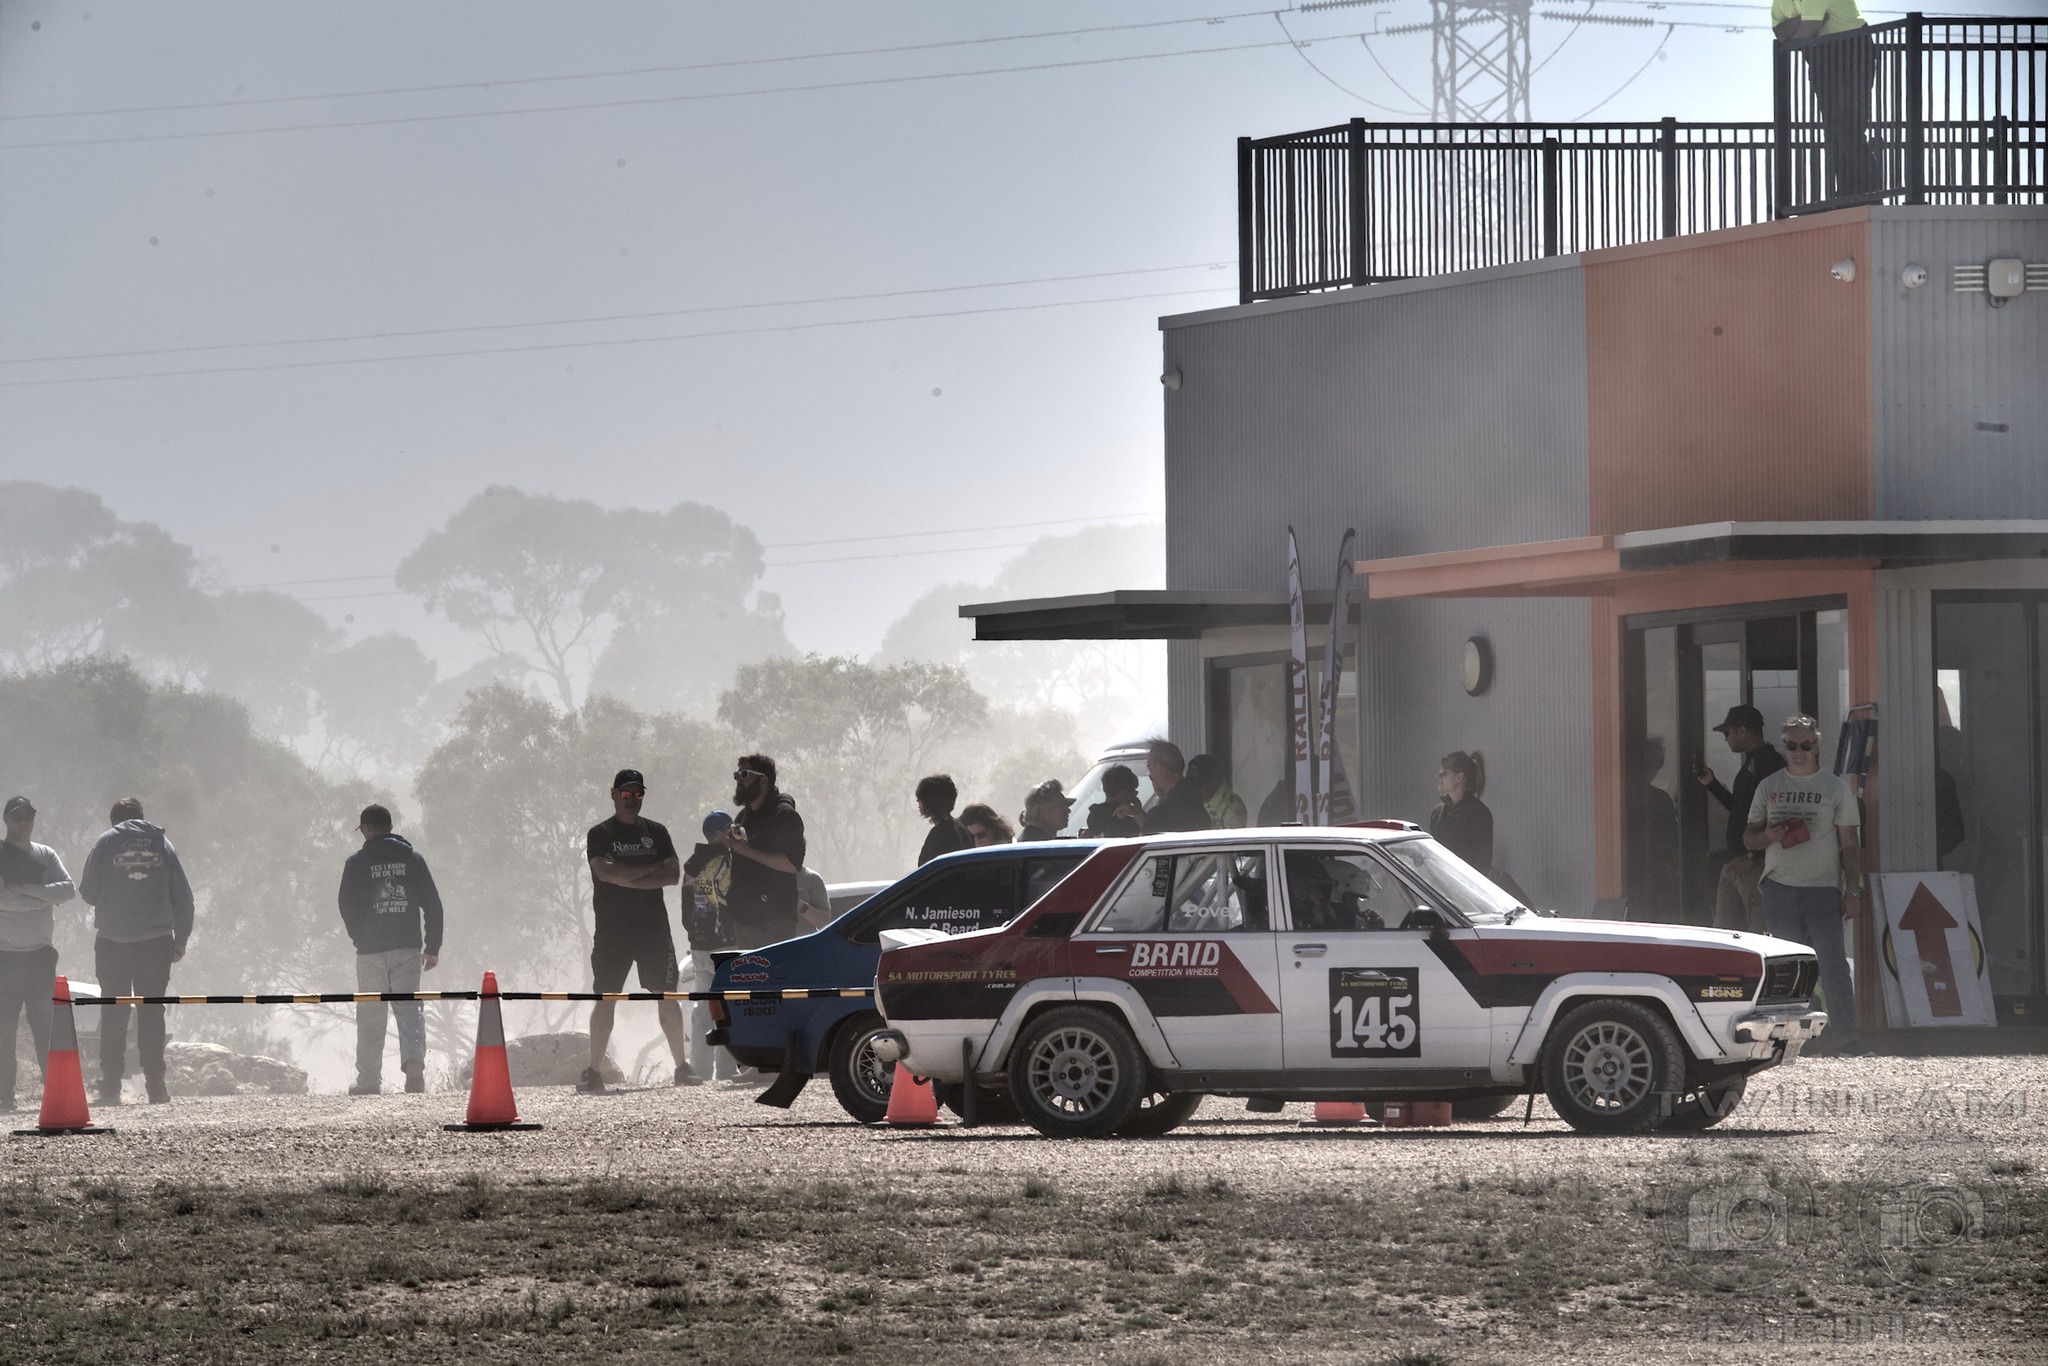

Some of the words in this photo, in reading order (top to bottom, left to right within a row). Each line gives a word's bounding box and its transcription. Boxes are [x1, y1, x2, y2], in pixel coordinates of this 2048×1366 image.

[1293, 656, 1307, 761] RALLY
[1770, 792, 1822, 804] RETIRED
[612, 841, 642, 852] Rotary
[370, 864, 383, 872] YES
[371, 870, 381, 879] I'M
[382, 869, 391, 878] ON
[392, 868, 406, 877] FIRE
[905, 906, 918, 920] N.
[921, 906, 980, 920] Jamieson
[1130, 942, 1220, 967] BRAID
[887, 972, 902, 981] SA
[905, 970, 979, 981] MOTORSPORT
[981, 969, 1017, 979] TYRES
[1128, 968, 1184, 977] COMPETITION
[1185, 968, 1220, 976] WHEELS
[1333, 993, 1417, 1050] 145
